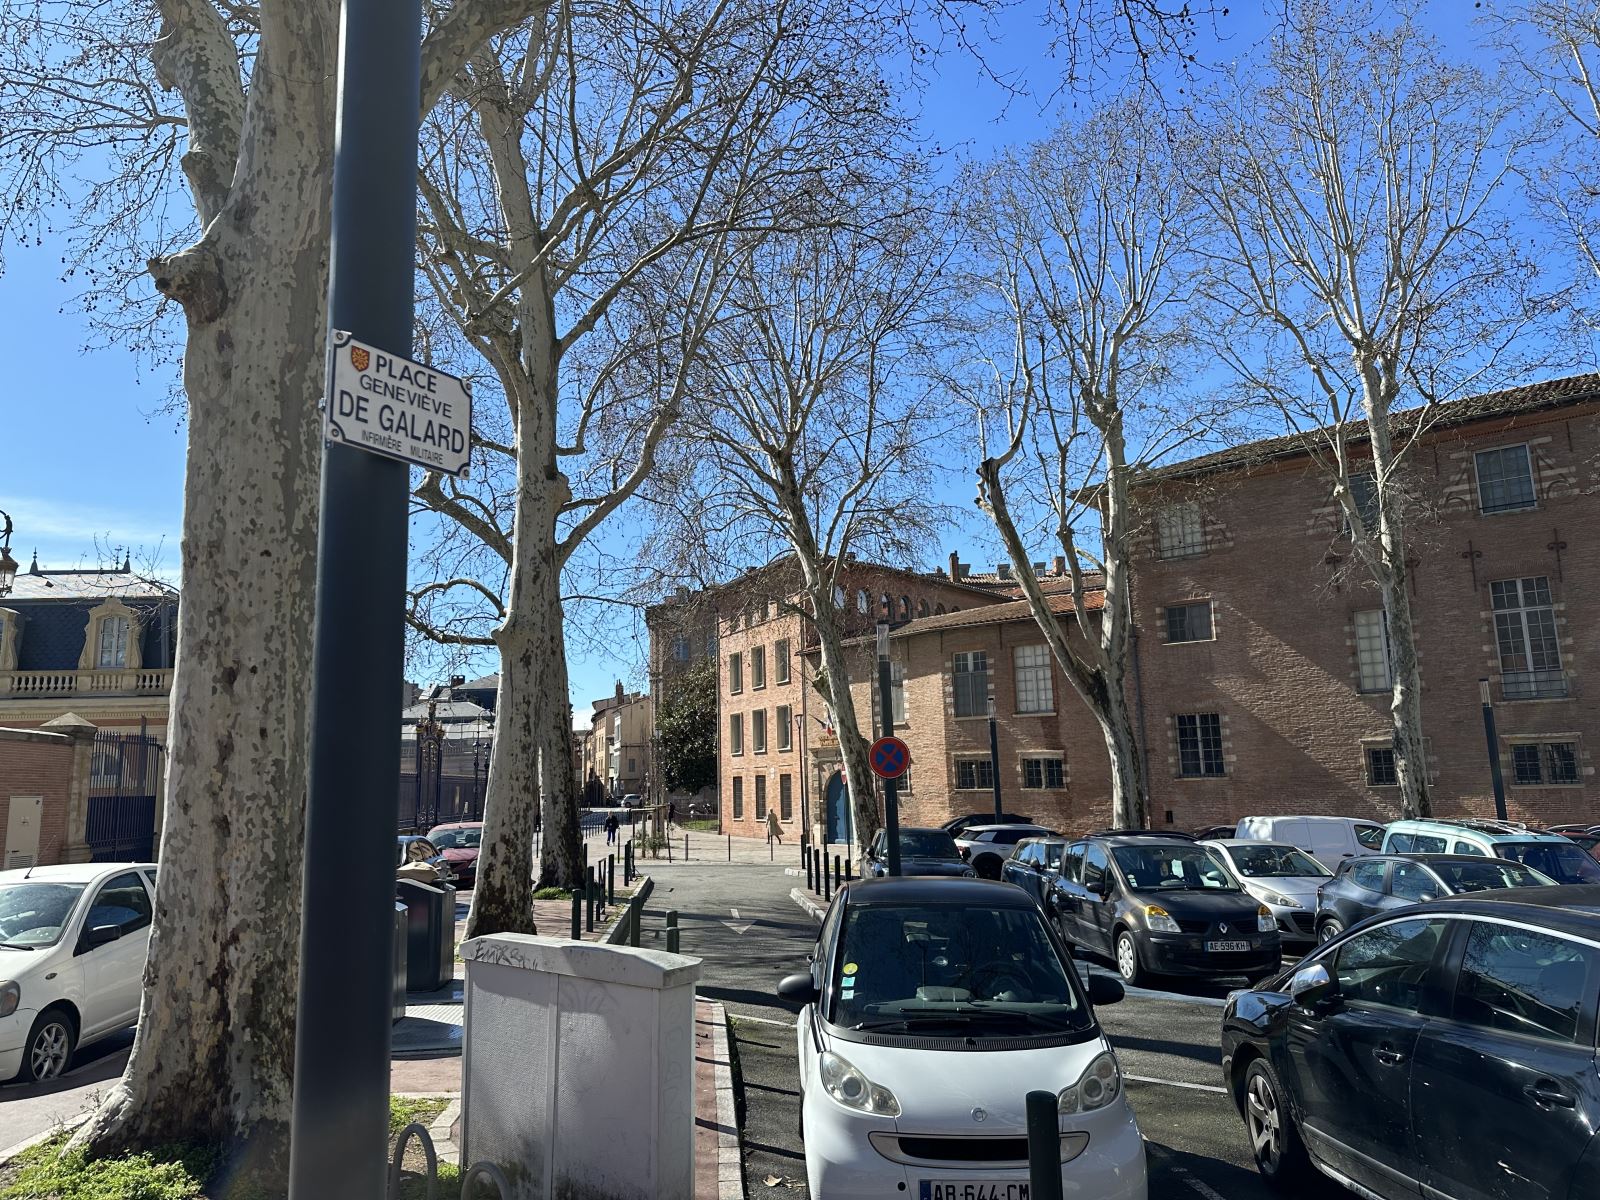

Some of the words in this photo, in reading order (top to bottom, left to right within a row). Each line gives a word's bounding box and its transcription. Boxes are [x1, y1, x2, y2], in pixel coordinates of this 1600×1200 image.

[376, 355, 437, 393] PLACE
[360, 374, 452, 418] GENEVIÈVE
[339, 389, 369, 423] DE
[379, 404, 464, 454] GALARD
[361, 429, 402, 452] INFIRMIÈRE
[410, 445, 443, 465] MILITAIRE
